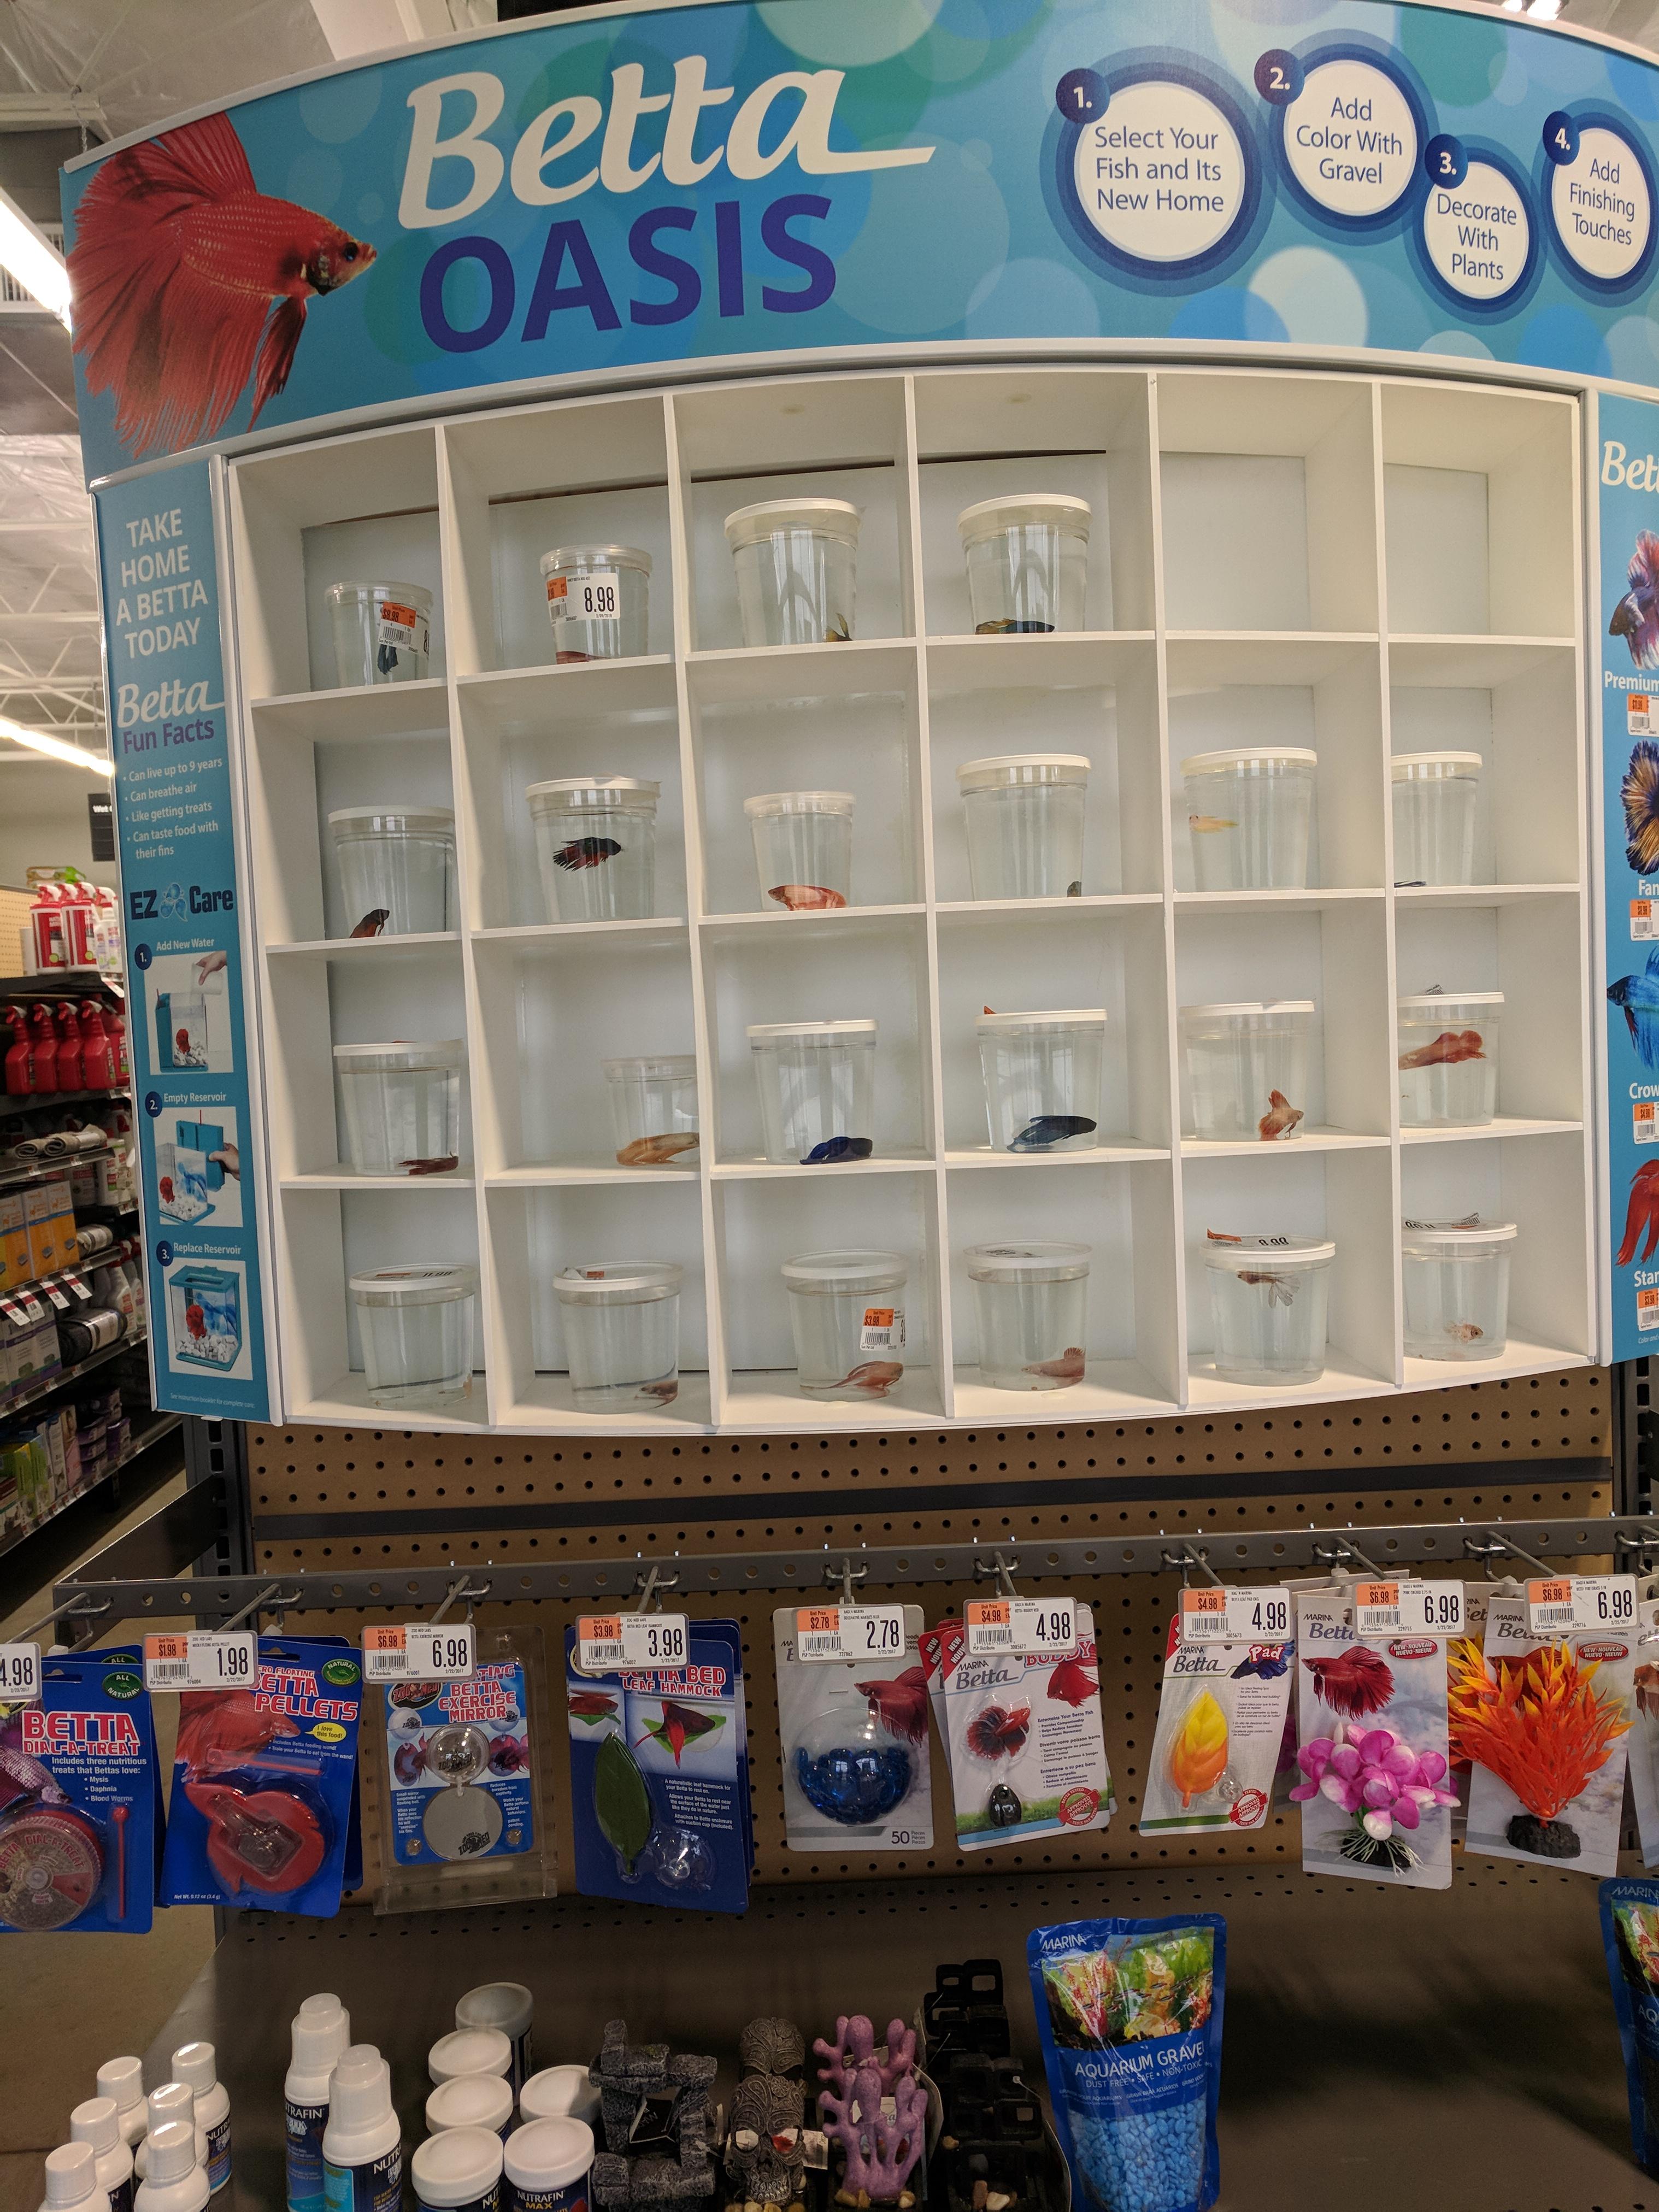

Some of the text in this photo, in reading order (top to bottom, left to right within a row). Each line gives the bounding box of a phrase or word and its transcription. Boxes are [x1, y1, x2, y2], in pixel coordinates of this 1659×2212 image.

[1269, 67, 1290, 90] 2.
[1073, 87, 1092, 108] 1.
[1331, 98, 1372, 121] Add
[398, 55, 936, 229] Betta
[1095, 127, 1219, 150] Select Your
[1296, 125, 1403, 157] Color With
[1554, 127, 1572, 150] 4.
[1096, 158, 1221, 181] Fish and Its
[1319, 158, 1384, 185] Gravel
[1439, 152, 1457, 175] 3.
[1590, 157, 1620, 184] Add
[1097, 189, 1225, 213] New Home
[1437, 193, 1517, 227] Decorate
[1569, 182, 1636, 222] Finishing
[1457, 225, 1499, 252] With
[1572, 211, 1633, 246] Touches
[420, 193, 836, 352] OASIS
[1451, 253, 1504, 281] Plants
[126, 508, 183, 548] TAKE
[121, 545, 190, 588] HOME
[116, 579, 208, 626] A BETTA
[584, 586, 615, 613] 8.98
[125, 617, 202, 659] TODAY
[117, 679, 225, 728] Betta
[123, 719, 215, 754] Fun Facts
[129, 757, 222, 782] Can live up to 9 years
[131, 781, 197, 802] Can breathe air
[132, 801, 213, 822] Like getting treats
[133, 819, 219, 843] Can taste food with
[136, 844, 174, 860] their fins
[130, 885, 234, 921] EZ Care
[156, 938, 215, 952] Add New Water
[139, 952, 148, 963] 1.
[150, 1099, 158, 1110] 2.
[163, 1091, 227, 1104] Empty Reservoir
[162, 1249, 170, 1260] 3.
[173, 1242, 242, 1255] Replace Reservoir
[1198, 1597, 1217, 1610] $4.98
[1369, 1591, 1390, 1604] $6.98
[1542, 1589, 1562, 1602] $6.98
[1598, 1590, 1633, 1620] 6.98
[981, 1609, 1001, 1622] $4.98
[1251, 1602, 1287, 1631] 4.98
[1303, 1613, 1334, 1622] MARINA
[1424, 1595, 1460, 1623] 6.98
[1493, 1614, 1524, 1622] MARINA
[593, 1625, 614, 1638] $3.98
[810, 1616, 829, 1630] $2.78
[1036, 1611, 1071, 1642] 4.98
[378, 1635, 398, 1648] $6.98
[648, 1628, 683, 1657] 3.98
[866, 1619, 899, 1649] 2.78
[948, 1636, 962, 1652] NEW
[158, 1644, 177, 1657] $1.98
[432, 1638, 467, 1668] 6.98
[1177, 1646, 1204, 1655] MARINA
[1250, 1646, 1284, 1663] Pad
[217, 1646, 249, 1677] 1.98
[327, 1661, 356, 1672] NATURAL
[957, 1660, 990, 1672] MARINA
[1173, 1655, 1226, 1673] Betta
[275, 1667, 316, 1678] FLOATING
[685, 1664, 727, 1686] BED
[955, 1668, 1019, 1690] Betta
[107, 1687, 140, 1698] NATURAL
[450, 1680, 502, 1697] BETTA
[622, 1678, 723, 1698] LEAF HAMMOCK
[254, 1693, 359, 1722] PELLETS
[438, 1691, 517, 1711] EXERCISE
[448, 1704, 508, 1723] MIRROR
[22, 1709, 141, 1743] BETTA
[22, 1739, 141, 1756] DIAL-A-TREAT
[52, 1757, 148, 1766] Includes three nutritious
[52, 1767, 75, 1775] treats
[94, 1767, 120, 1775] Bettas
[121, 1767, 141, 1775] love:
[89, 1776, 109, 1784] Mysis
[90, 1786, 117, 1794] Daphnia
[891, 1831, 910, 1844] 50
[1042, 1933, 1087, 1951] MARINA
[1075, 2052, 1155, 2081] AQUARIUM
[1085, 2061, 1202, 2089] DUST FREE SAFE NON-TOXIC
[516, 2189, 565, 2203] NUTRAFIN
[525, 2201, 554, 2210] MAX
